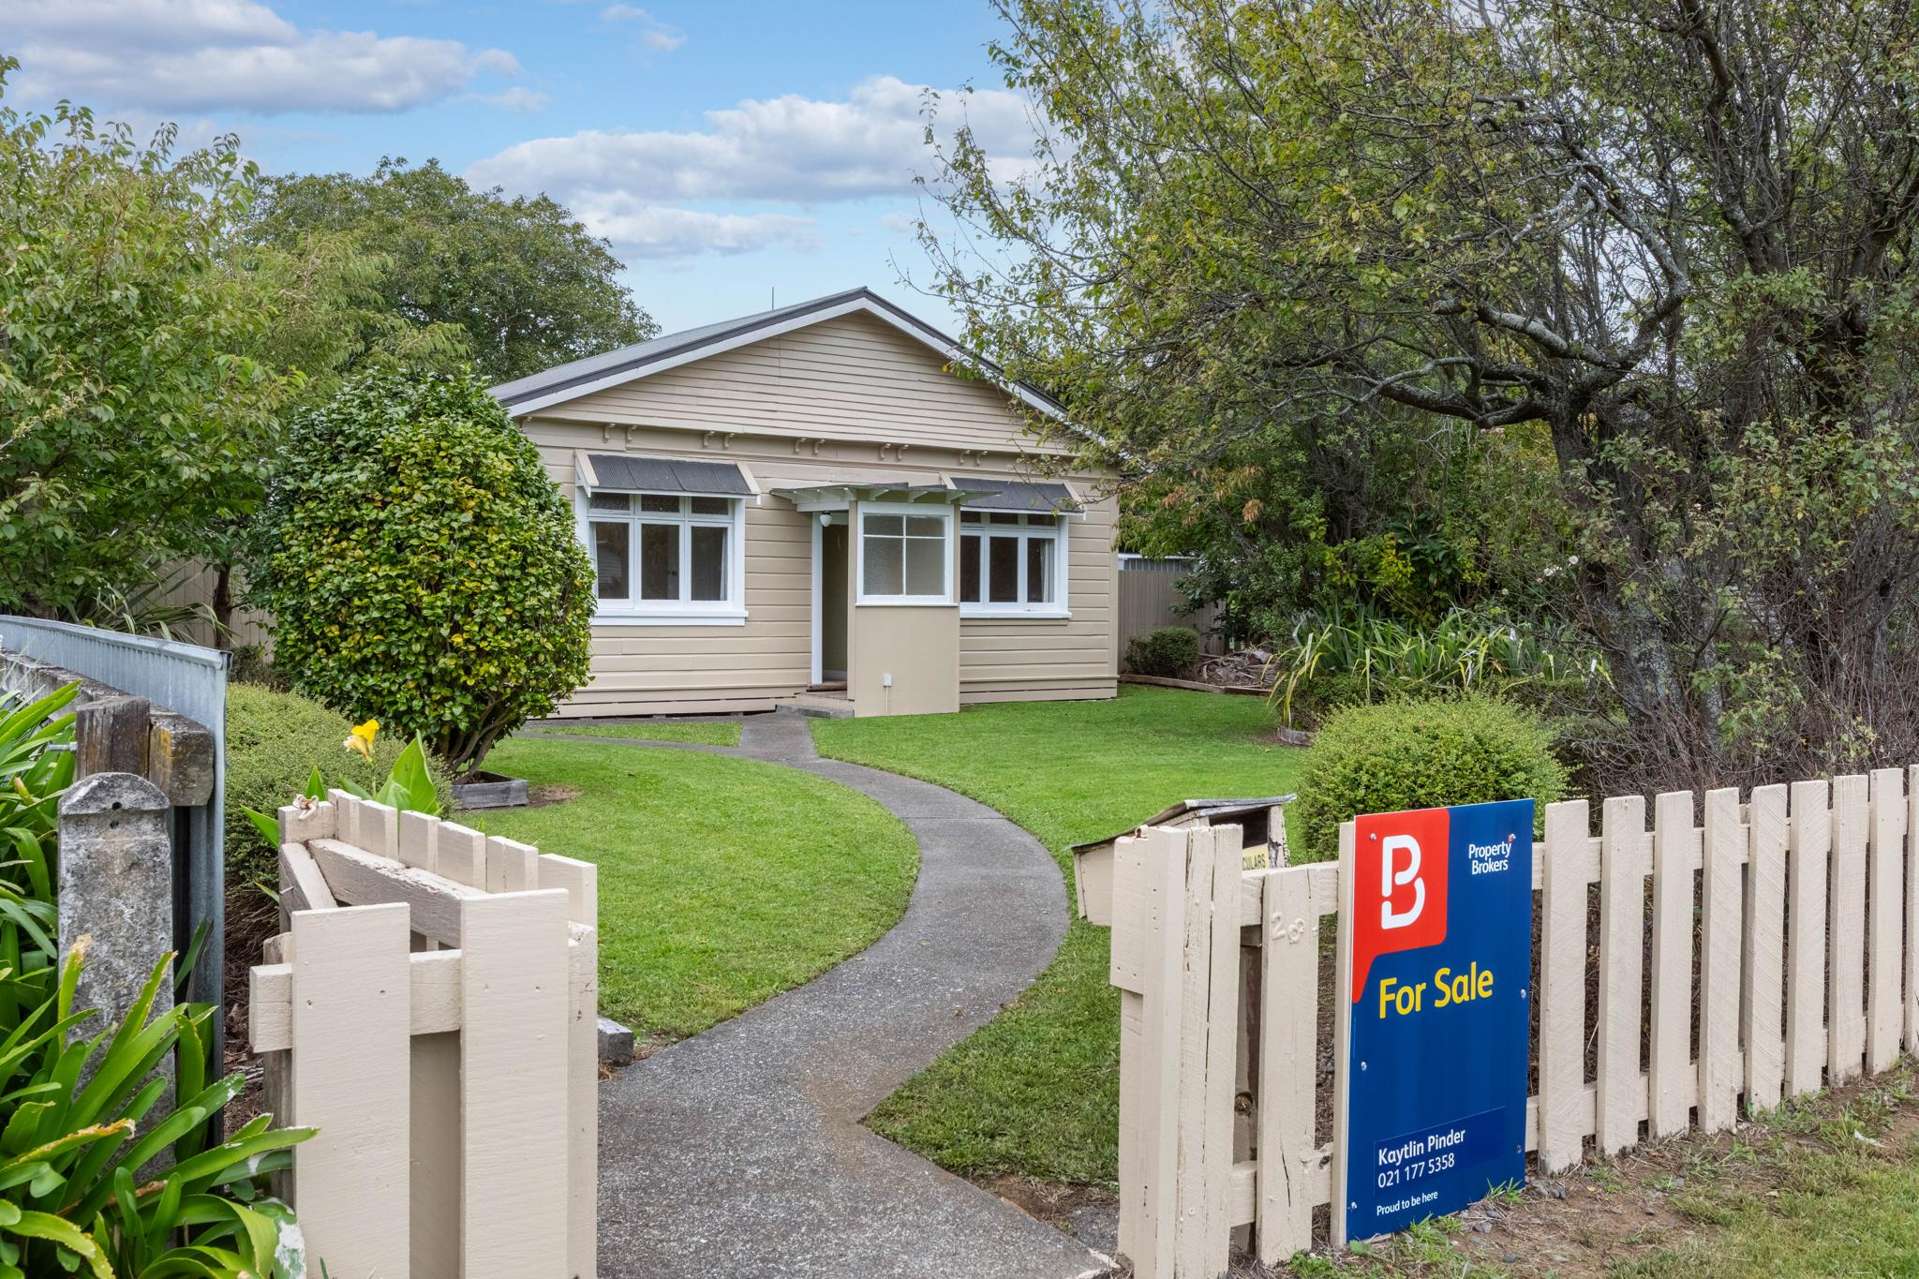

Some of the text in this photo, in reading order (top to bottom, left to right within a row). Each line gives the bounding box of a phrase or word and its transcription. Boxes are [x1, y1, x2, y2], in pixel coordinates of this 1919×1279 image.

[1468, 841, 1512, 861] Property
[1472, 857, 1508, 875] Brokers
[1379, 961, 1494, 1019] For Sale
[1378, 1128, 1466, 1166] Kaytlin Pinder
[1377, 1152, 1455, 1188] 021 177 5358
[1376, 1191, 1439, 1216] Proud to be here
